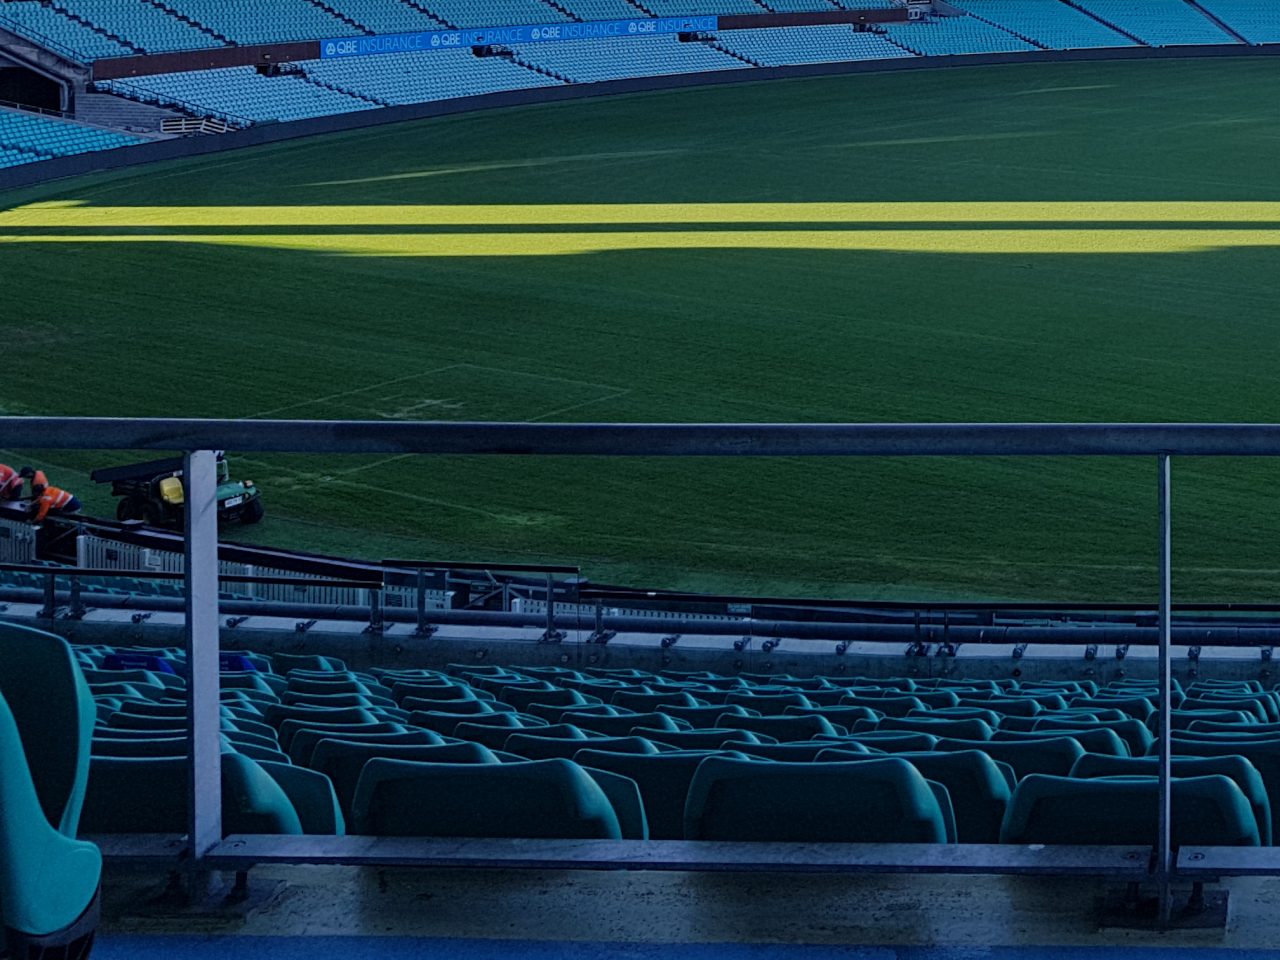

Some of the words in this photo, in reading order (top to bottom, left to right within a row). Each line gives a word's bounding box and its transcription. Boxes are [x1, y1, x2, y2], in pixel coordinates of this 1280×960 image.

[542, 27, 560, 38] QBE
[562, 23, 620, 37] INSURANCE
[638, 21, 657, 32] QBE
[337, 41, 358, 54] QBE
[359, 35, 422, 53] INSURANCE
[441, 33, 461, 46] QBE
